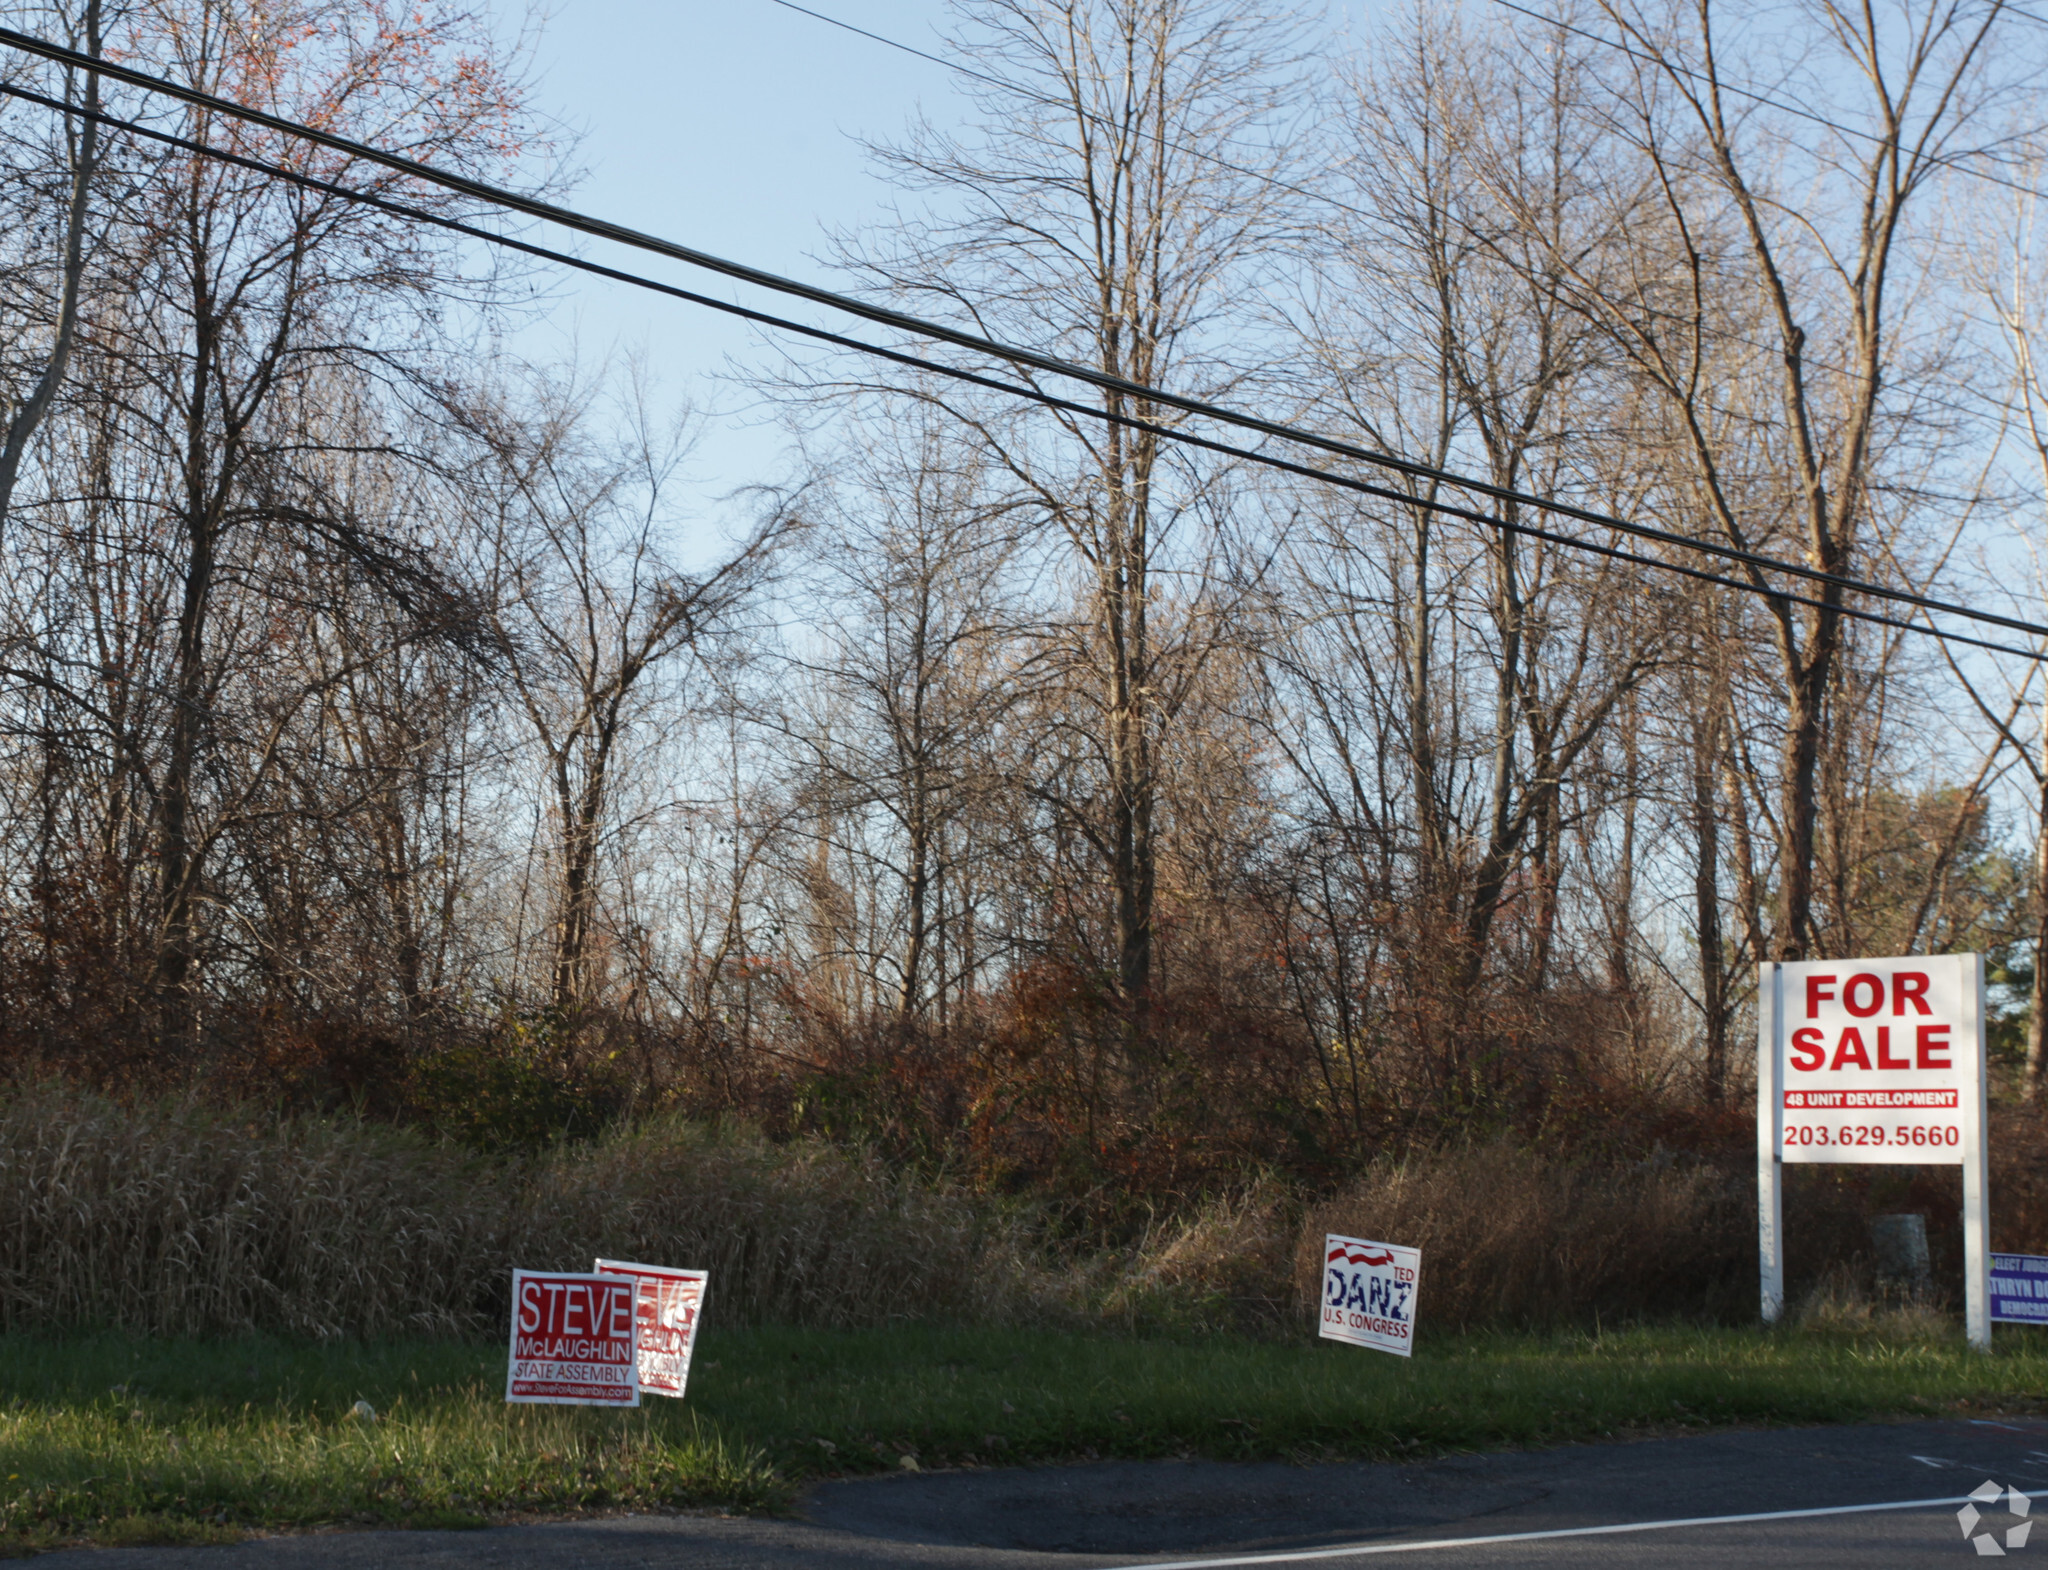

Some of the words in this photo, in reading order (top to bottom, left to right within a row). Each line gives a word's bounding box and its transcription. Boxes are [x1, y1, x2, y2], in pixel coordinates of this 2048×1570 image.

[1806, 971, 1933, 1019] FOR
[1790, 1024, 1952, 1072] SALE
[1786, 1093, 1804, 1107] 48
[1807, 1092, 1843, 1106] UNIT
[1846, 1091, 1956, 1106] DEVELOPMENT
[1784, 1125, 1959, 1146] 203.629.5660
[1393, 1266, 1415, 1282] TED
[1326, 1268, 1412, 1322] DANZ
[519, 1281, 630, 1338] STEVE
[1323, 1307, 1346, 1326] U.S.
[1349, 1312, 1408, 1339] CONGRESS
[517, 1337, 630, 1361] McLAUGHLIN
[515, 1362, 552, 1379] STATE
[556, 1364, 630, 1383] ASSEMBLY
